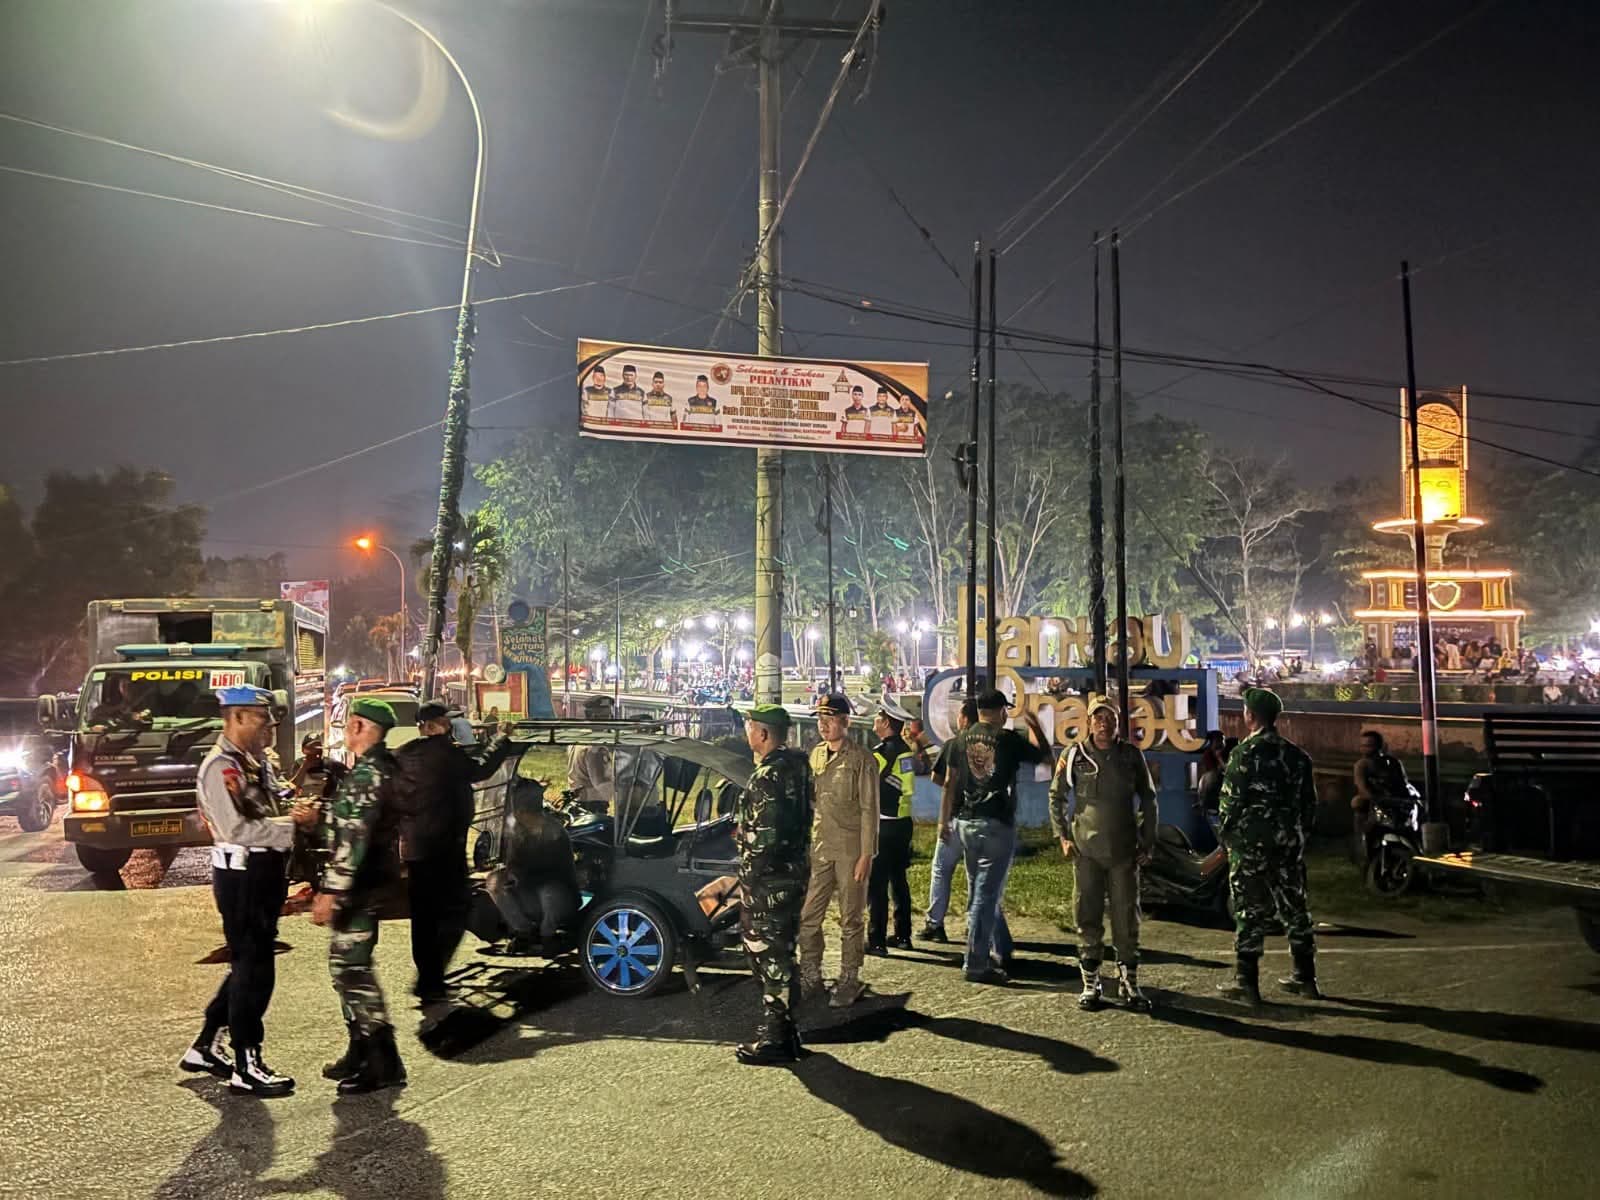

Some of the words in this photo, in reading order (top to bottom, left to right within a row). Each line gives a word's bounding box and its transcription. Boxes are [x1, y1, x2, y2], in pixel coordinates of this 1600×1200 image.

[735, 364, 777, 376] Selamat
[780, 368, 789, 376] &
[749, 375, 812, 387] PELANTIKAN
[131, 670, 203, 681] POLISI
[211, 673, 244, 687] 110
